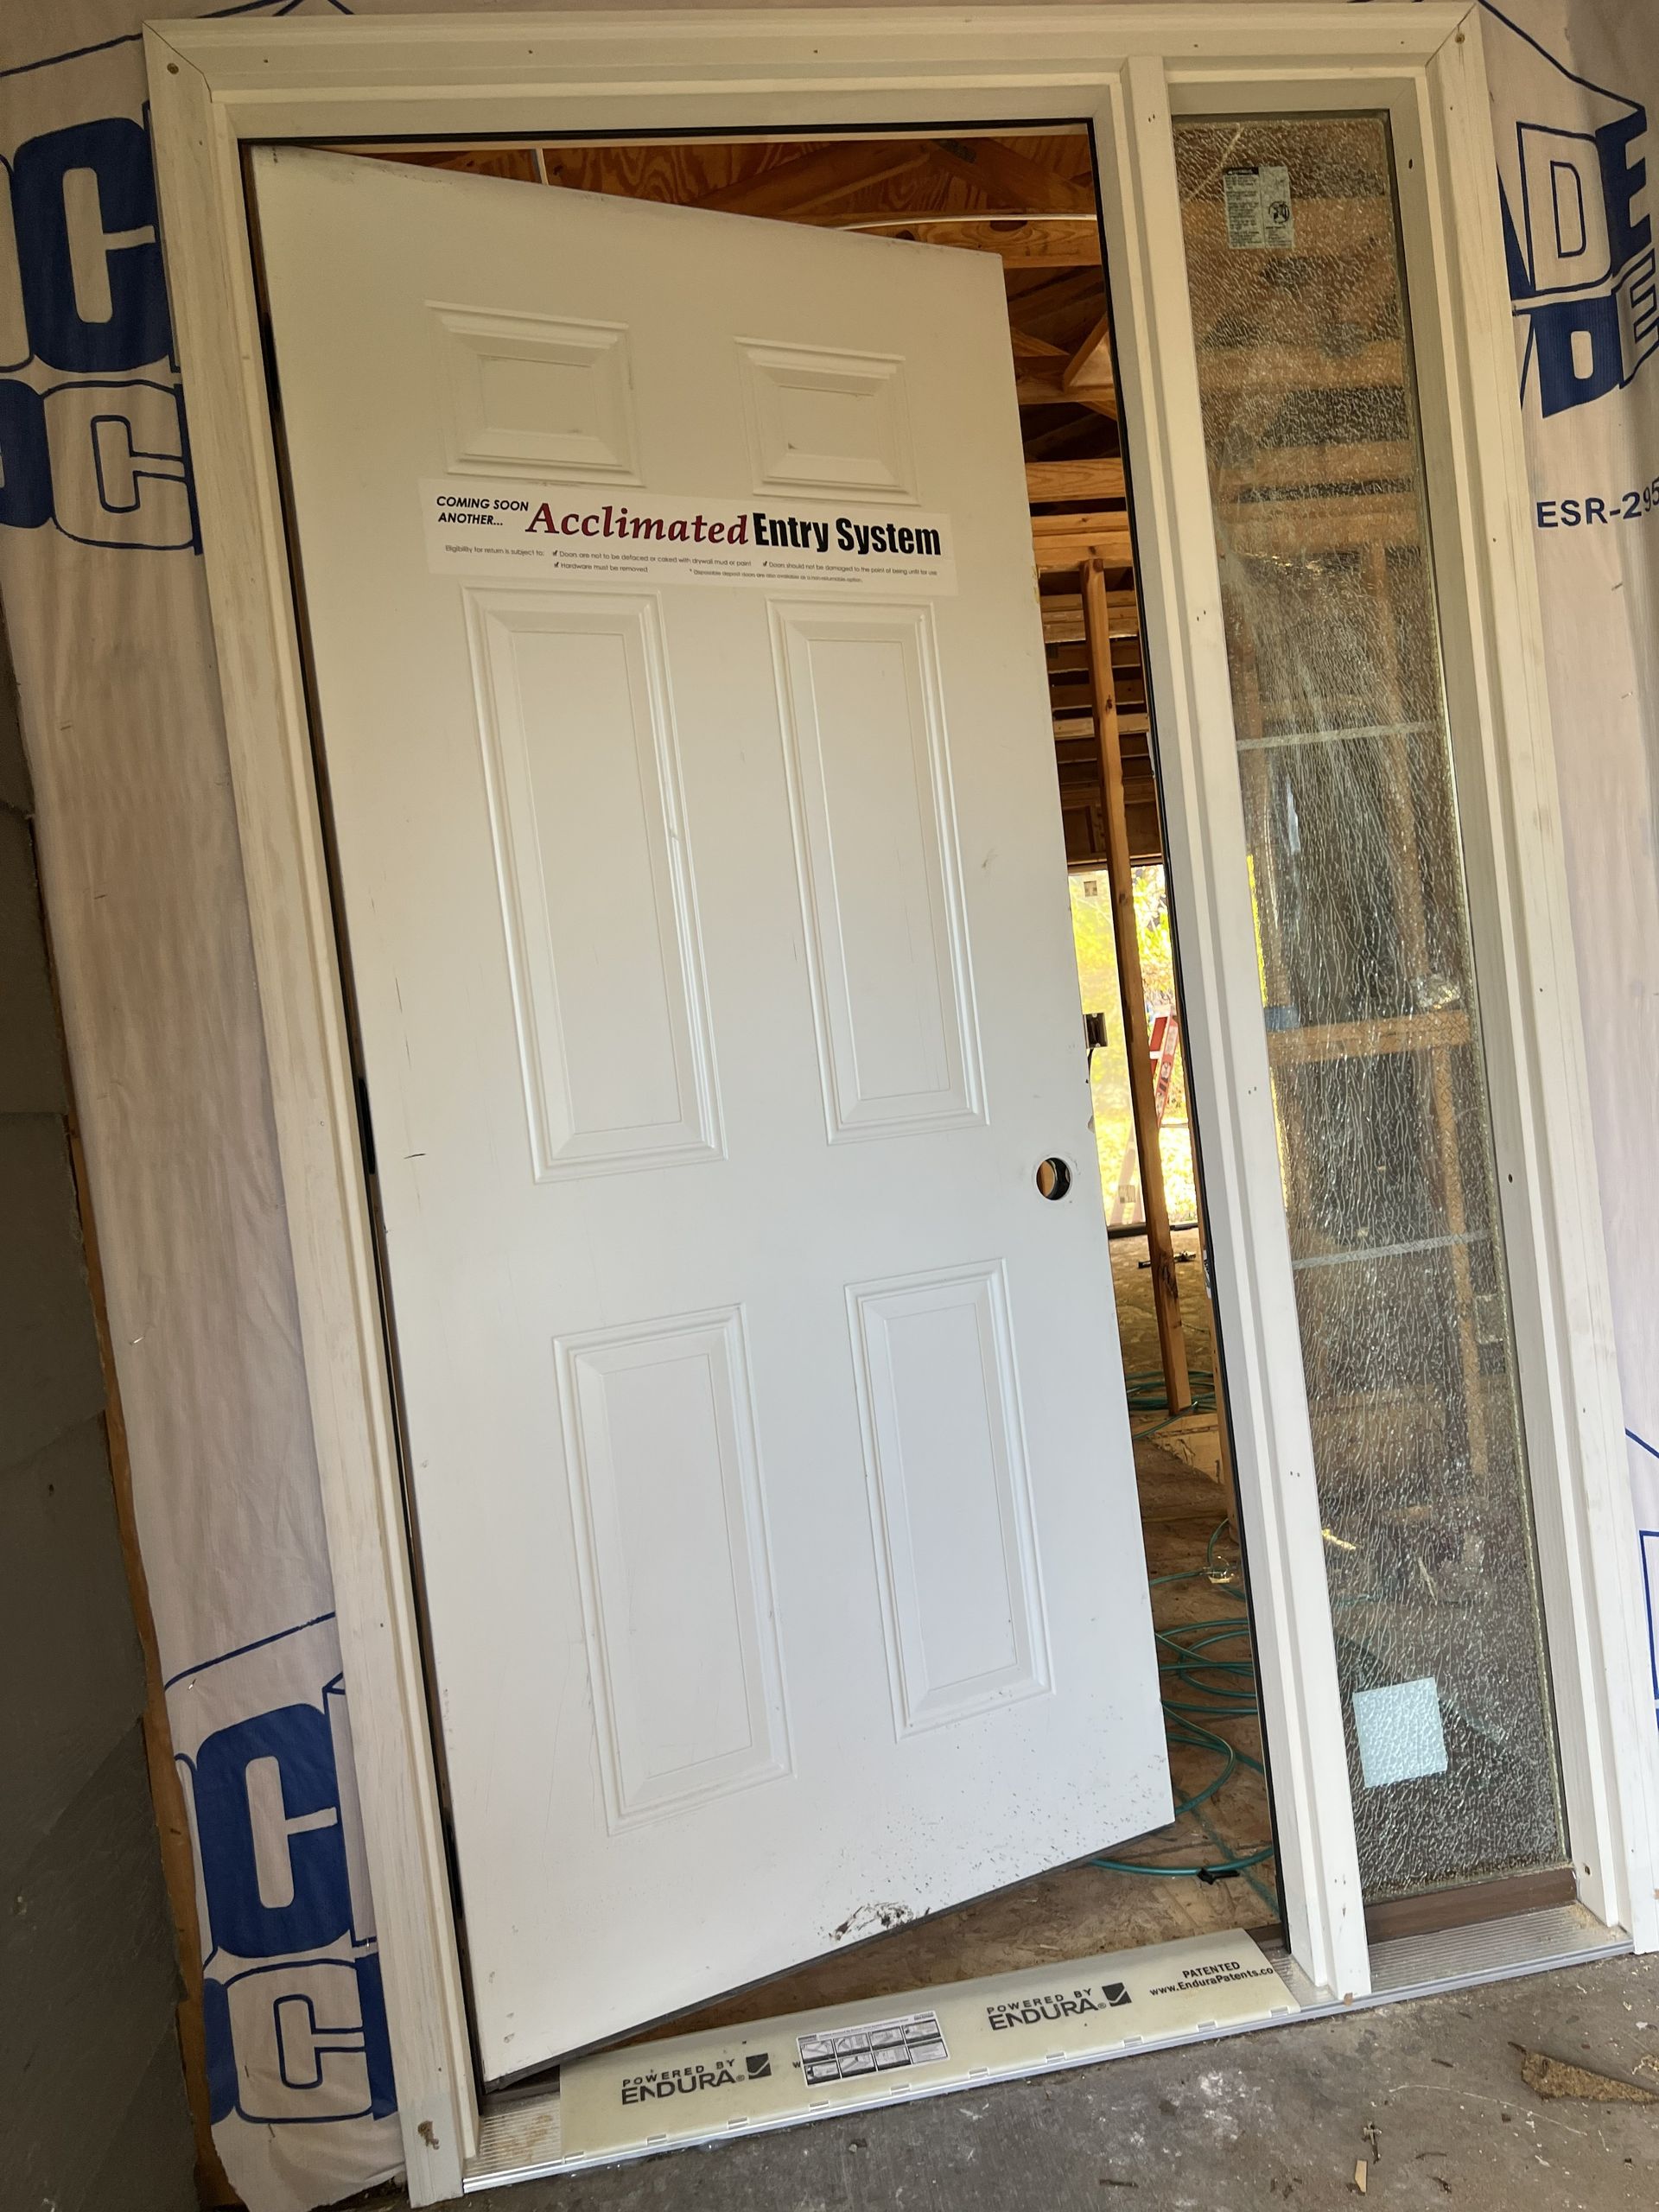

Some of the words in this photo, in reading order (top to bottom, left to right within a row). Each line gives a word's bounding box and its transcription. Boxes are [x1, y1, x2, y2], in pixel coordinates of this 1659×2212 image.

[436, 496, 490, 510] COMING
[493, 499, 529, 512] SOON
[438, 512, 503, 525] ANOTHER...
[524, 502, 749, 545] Acclimated
[753, 512, 830, 553] Entry
[836, 518, 942, 556] System
[692, 557, 714, 566] drywall
[825, 564, 854, 573] damaged
[1182, 1961, 1241, 1979] PATENTED
[1149, 1967, 1274, 1997] www.EnduraPatents.co
[987, 1994, 1065, 2015] POWERED
[1073, 1988, 1092, 1999] BY
[622, 2065, 705, 2088] POWERED
[715, 2058, 735, 2070] BY
